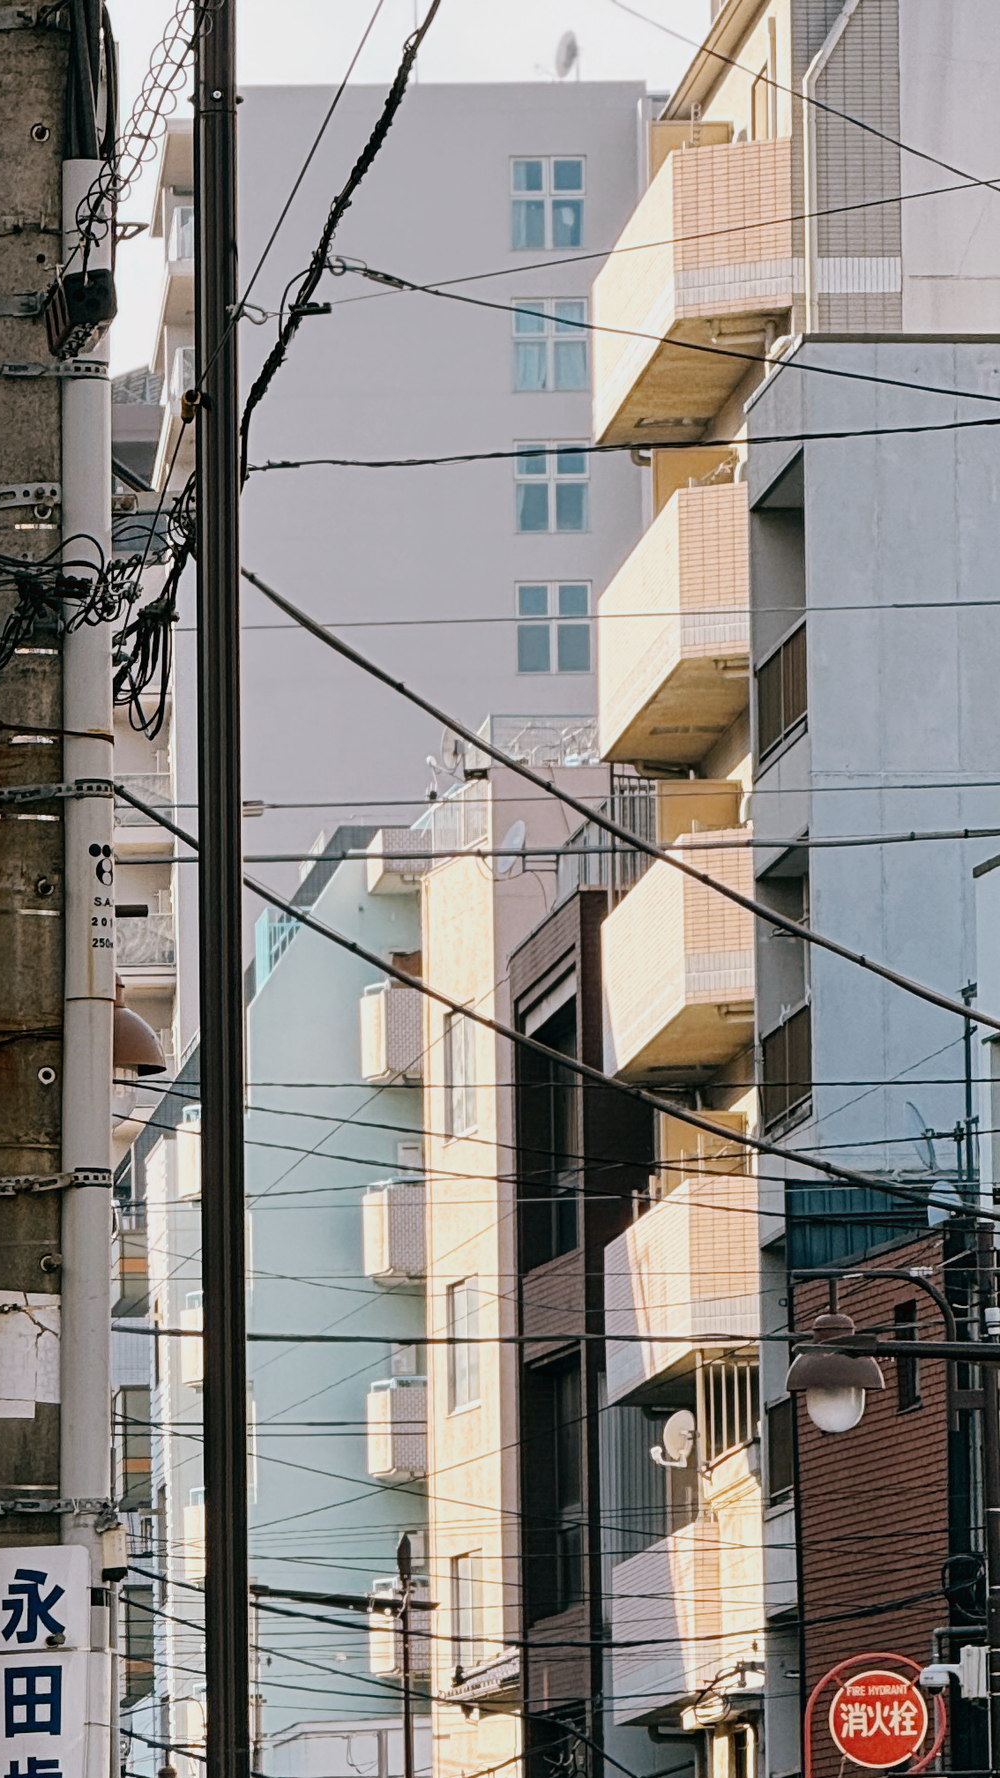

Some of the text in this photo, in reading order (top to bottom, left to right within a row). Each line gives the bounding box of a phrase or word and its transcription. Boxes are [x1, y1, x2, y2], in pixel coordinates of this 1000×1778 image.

[845, 1683, 909, 1697] FIRE HYDRANT
[839, 1700, 919, 1739] 消火栓
